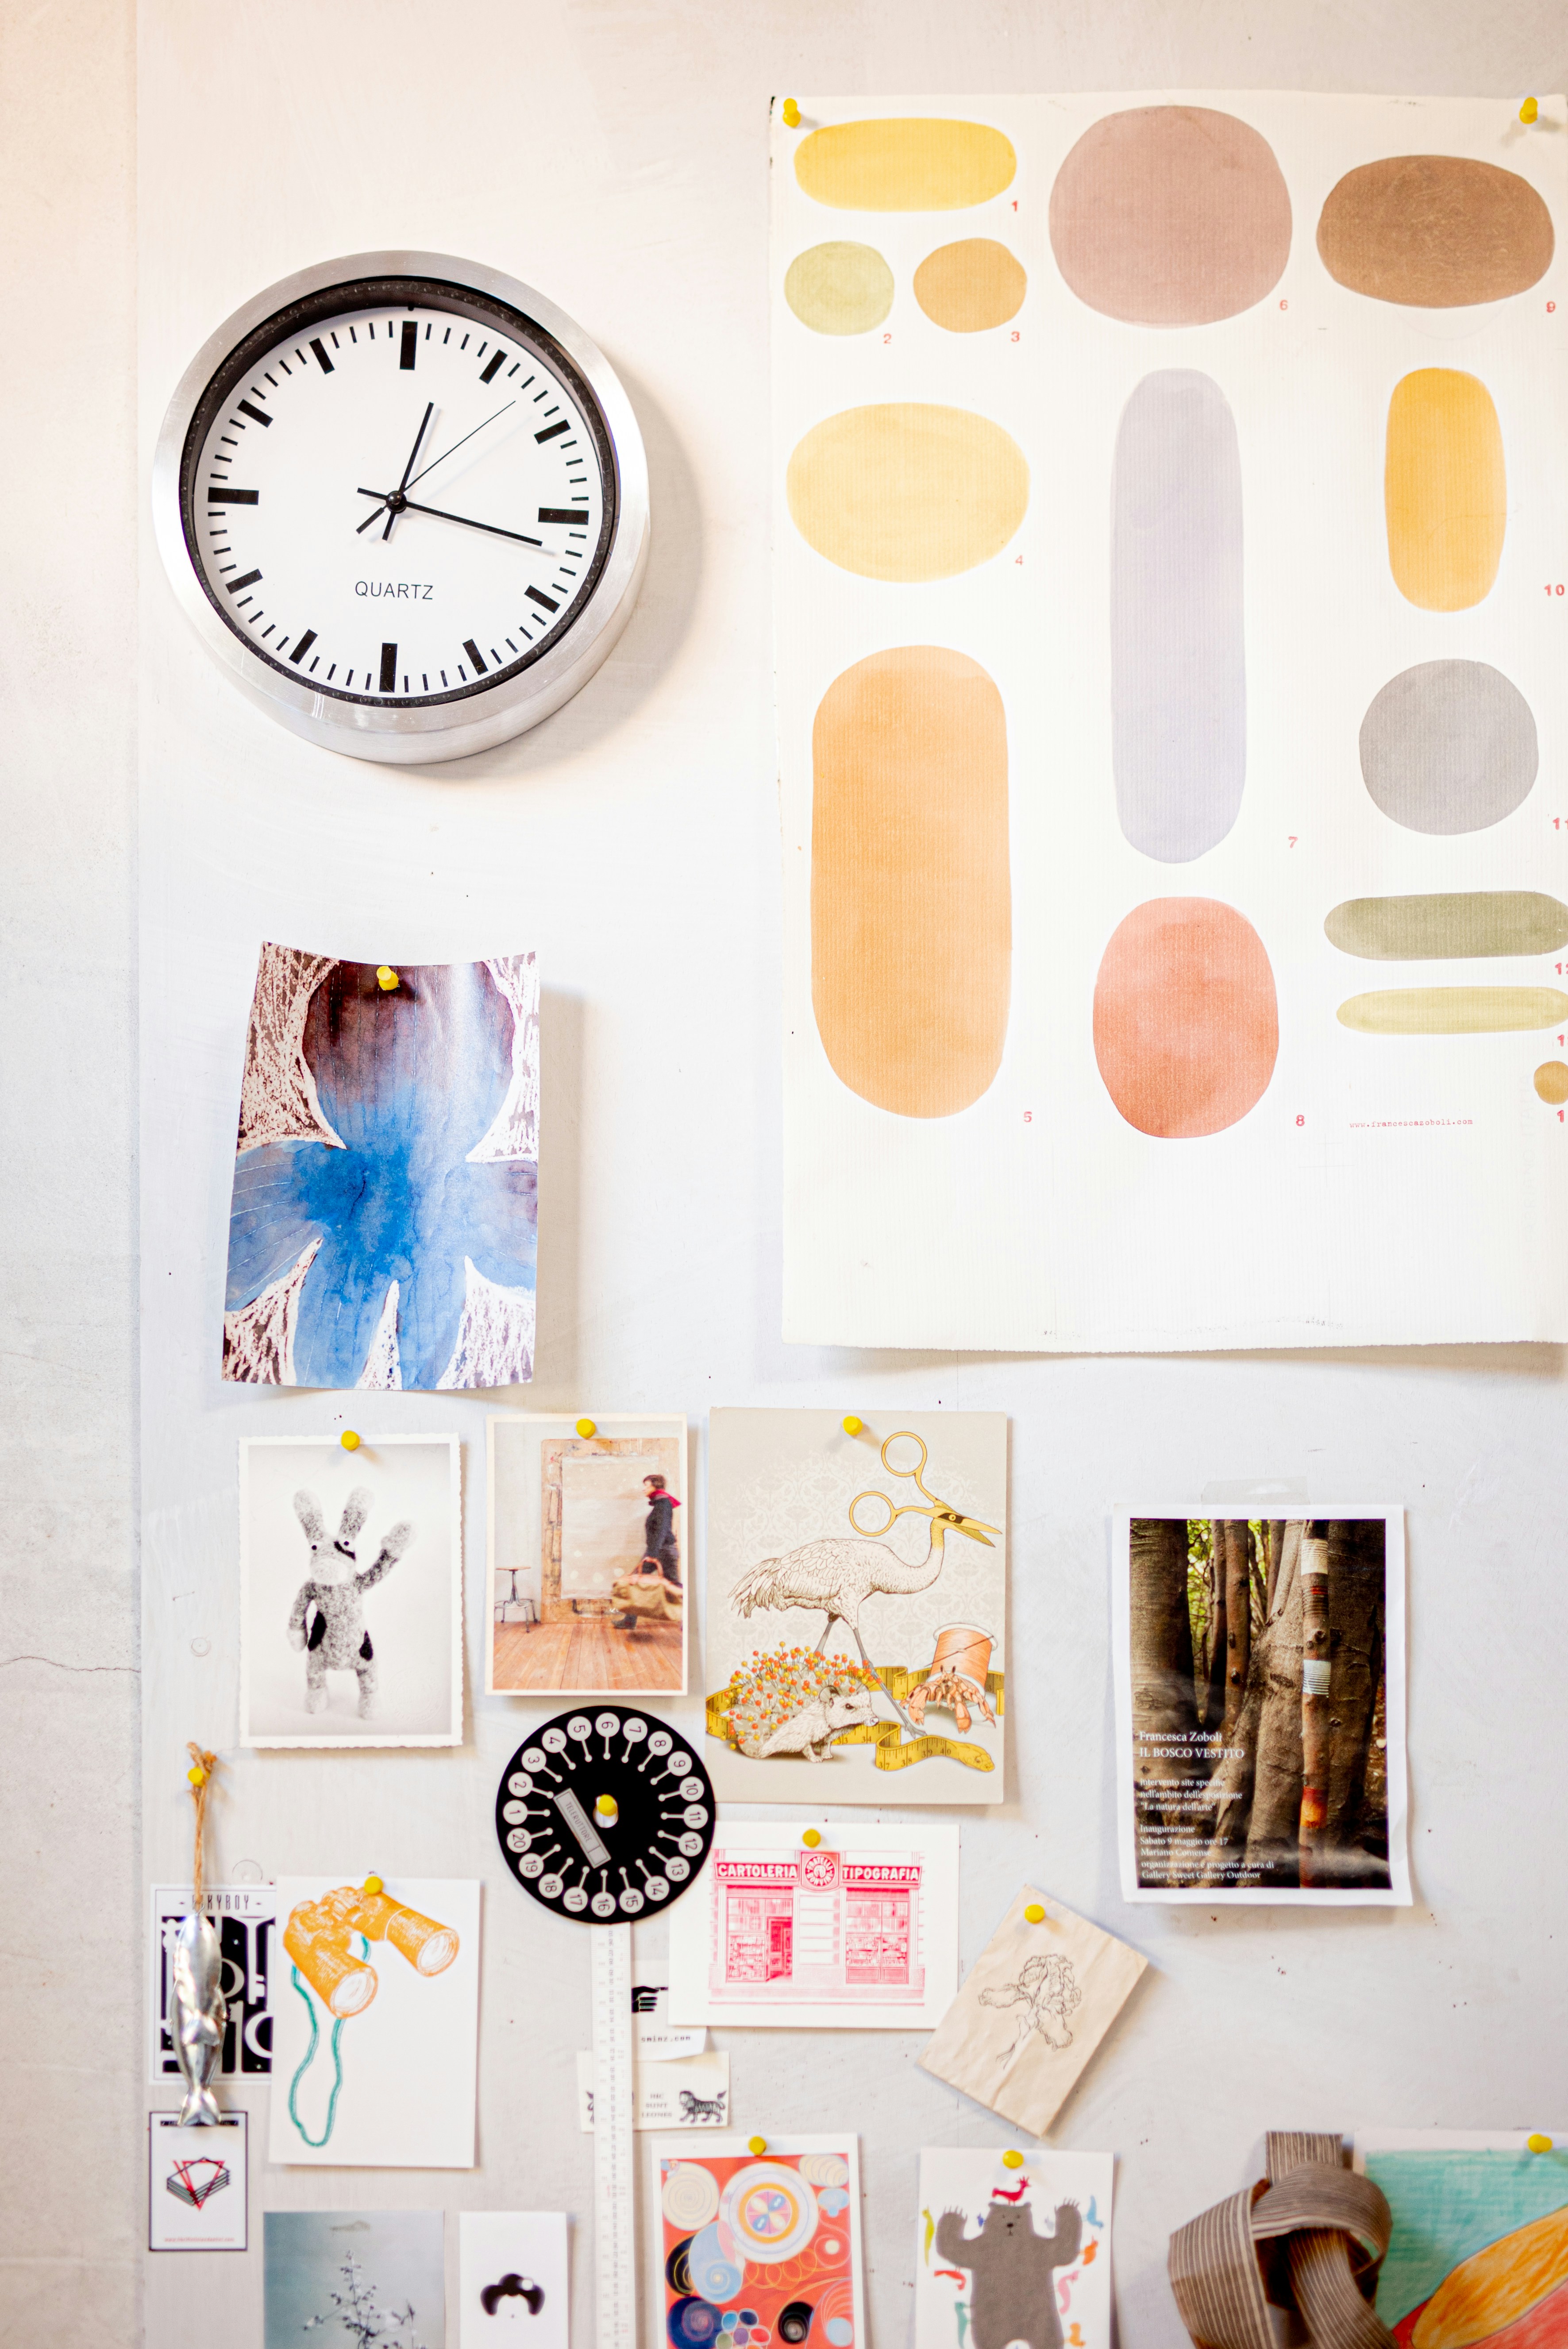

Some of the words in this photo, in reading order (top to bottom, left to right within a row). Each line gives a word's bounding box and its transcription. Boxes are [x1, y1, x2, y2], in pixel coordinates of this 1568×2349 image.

[1011, 200, 1018, 212] 1
[1279, 300, 1287, 310] 6
[1546, 301, 1556, 313] 9
[883, 333, 891, 344] 2
[1011, 331, 1020, 342] 3
[1015, 555, 1023, 565] 4
[355, 581, 433, 599] QUARTZ
[1544, 584, 1565, 596] 10
[1288, 836, 1298, 848] 7
[1555, 963, 1568, 975] 1
[1024, 1111, 1032, 1122] 5
[1295, 1115, 1305, 1126] 8
[1349, 1119, 1473, 1128] www.francescazoboli.com
[1140, 1731, 1187, 1742] Francesca
[1190, 1731, 1222, 1742] Zoboli
[1140, 1747, 1150, 1757] IL
[1153, 1748, 1192, 1758] BOSCO
[1195, 1748, 1244, 1758] VESTITO
[686, 1783, 698, 1795] 10
[690, 1812, 701, 1821] 11
[1140, 1824, 1195, 1835] Inaugurazione
[513, 1834, 525, 1848] 20
[685, 1838, 697, 1851] 12
[1175, 1838, 1202, 1847] maggio
[526, 1860, 538, 1872] 19
[671, 1863, 684, 1875] 13
[718, 1864, 797, 1878] CARTOLERIA
[1141, 1861, 1199, 1870] organizzazione
[1207, 1861, 1239, 1870] progetto
[842, 1867, 919, 1880] TIPOGRAFIA
[1142, 1870, 1170, 1880] Gallery
[1196, 1871, 1225, 1880] Gallery
[1226, 1871, 1261, 1879] Outdoor
[545, 1880, 557, 1893] 18
[651, 1882, 663, 1896] 14
[192, 1894, 249, 1910] KYBOY
[570, 1894, 582, 1907] 17
[598, 1898, 610, 1911] 16
[625, 1895, 638, 1907] 15
